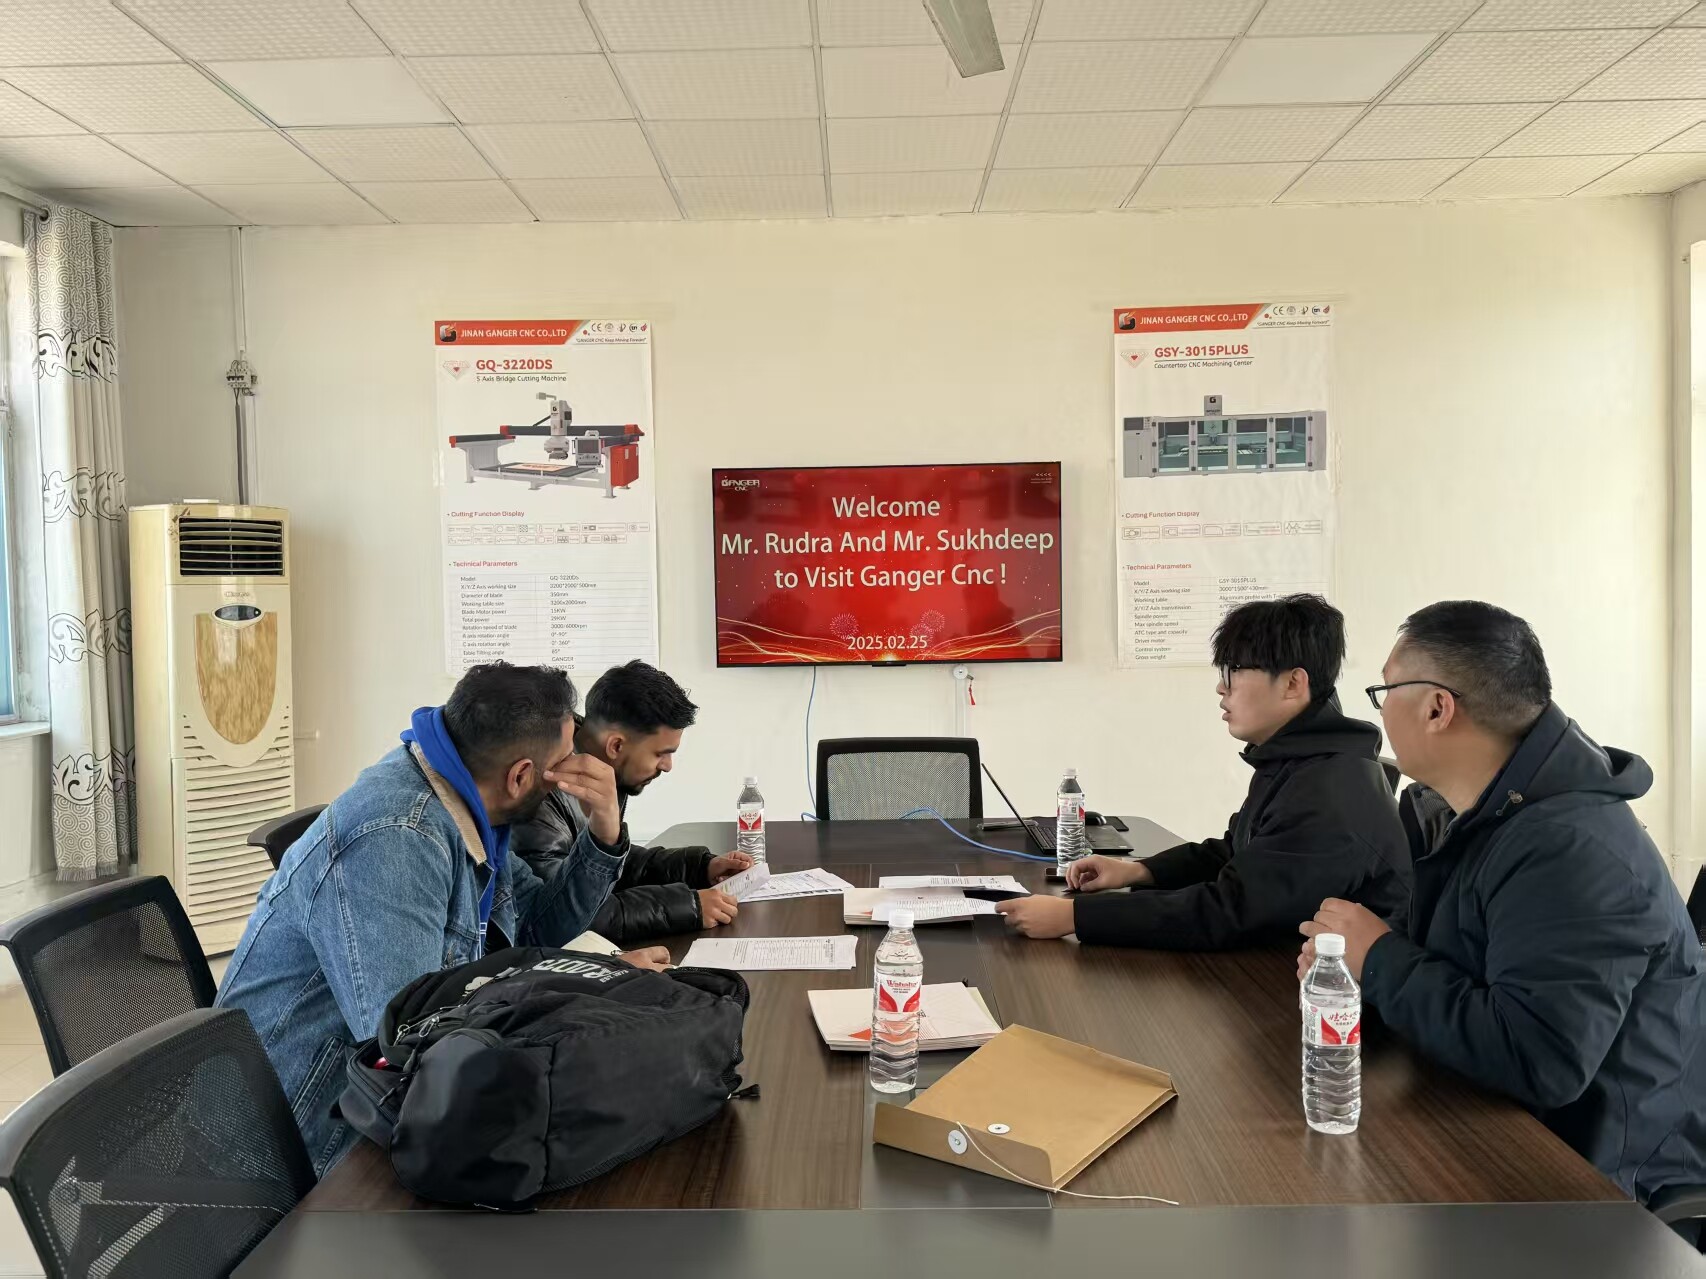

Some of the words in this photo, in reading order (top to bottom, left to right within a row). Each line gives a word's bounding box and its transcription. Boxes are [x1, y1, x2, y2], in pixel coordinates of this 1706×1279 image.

[1140, 316, 1163, 324] JINAN
[1165, 315, 1198, 323] GANGER
[1217, 313, 1248, 322] CO.,LTD
[460, 329, 484, 337] JINAN
[519, 329, 535, 337] CNC
[537, 329, 567, 338] CO.,LTD
[1154, 344, 1249, 358] GSY-3015PLUS
[476, 359, 553, 372] GQ-3220DS
[832, 495, 941, 518] Welcome
[721, 533, 759, 555] Mr.
[765, 532, 833, 554] Rudra
[839, 530, 886, 552] And
[893, 530, 930, 552] Mr.
[937, 528, 1054, 555] Sukhdeep
[774, 569, 799, 588] to
[804, 566, 854, 588] Visit
[860, 565, 945, 592] Ganger
[951, 564, 994, 585] Cnc
[847, 635, 928, 650] 2025.02.25
